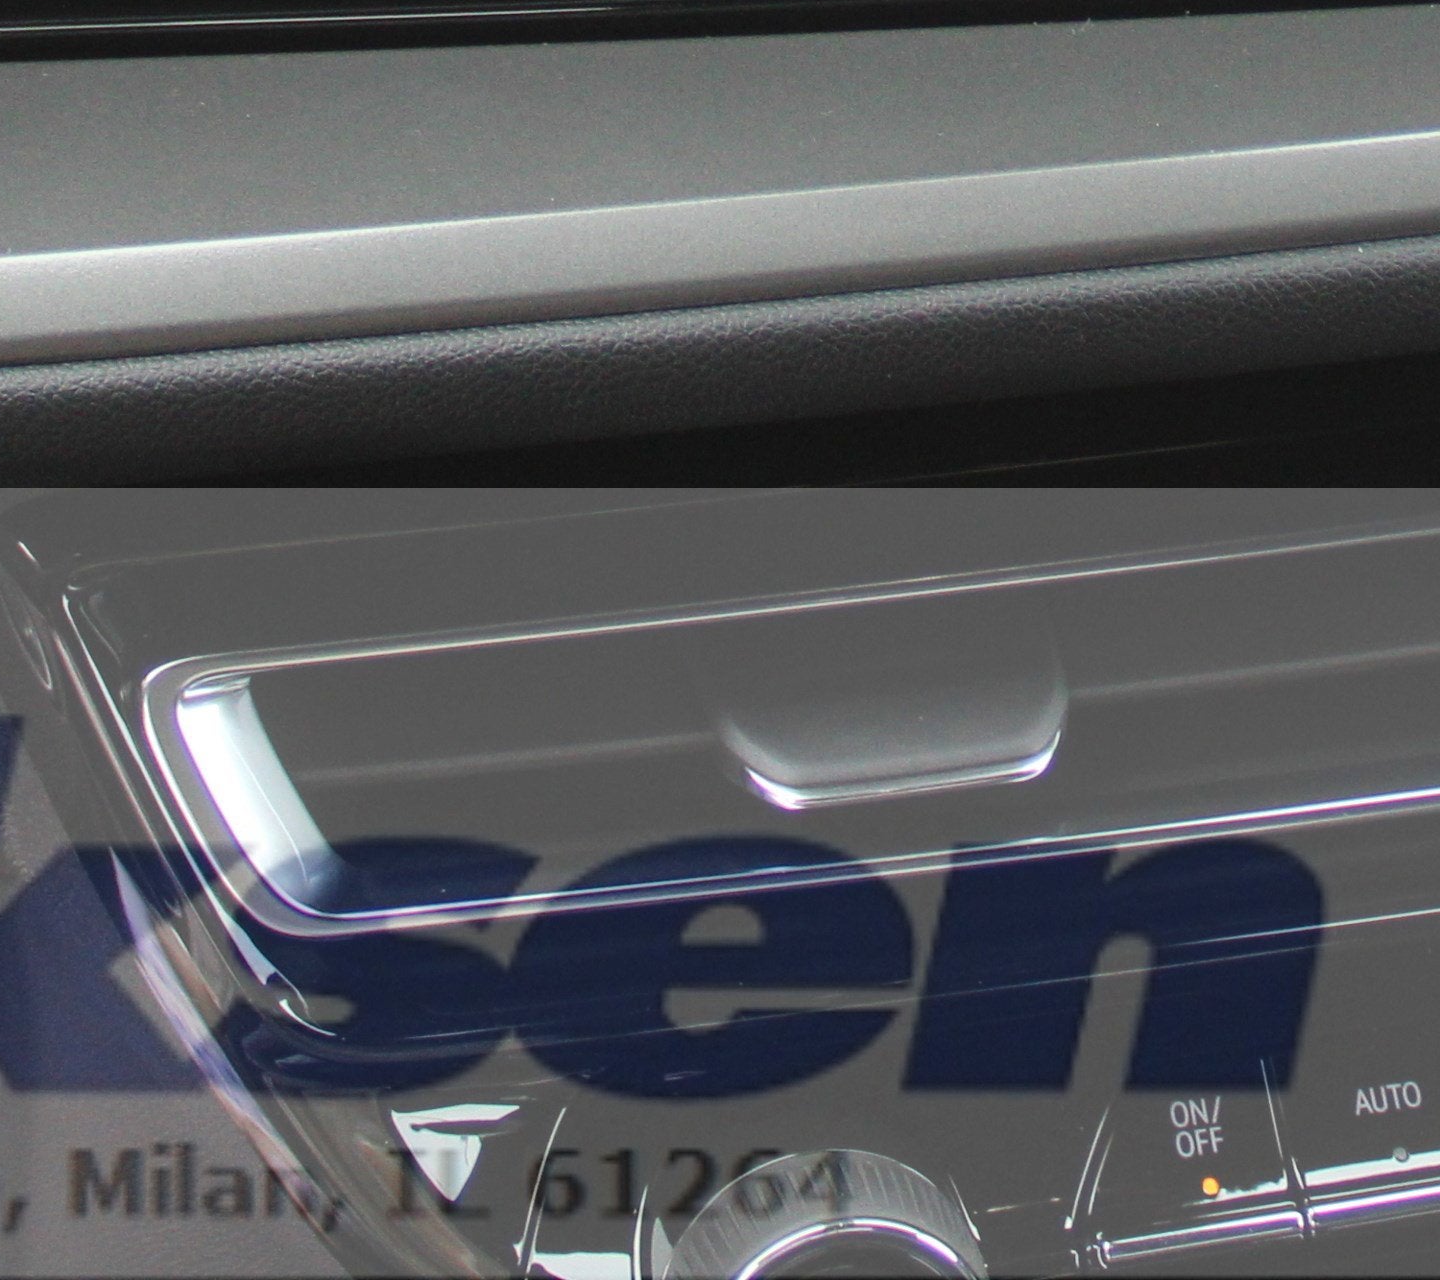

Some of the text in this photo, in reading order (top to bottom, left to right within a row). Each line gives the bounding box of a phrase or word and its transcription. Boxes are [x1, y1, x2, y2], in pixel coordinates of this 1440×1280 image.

[1170, 1095, 1222, 1130] ON/
[1355, 1080, 1422, 1117] AUTO
[1175, 1125, 1224, 1159] OFF
